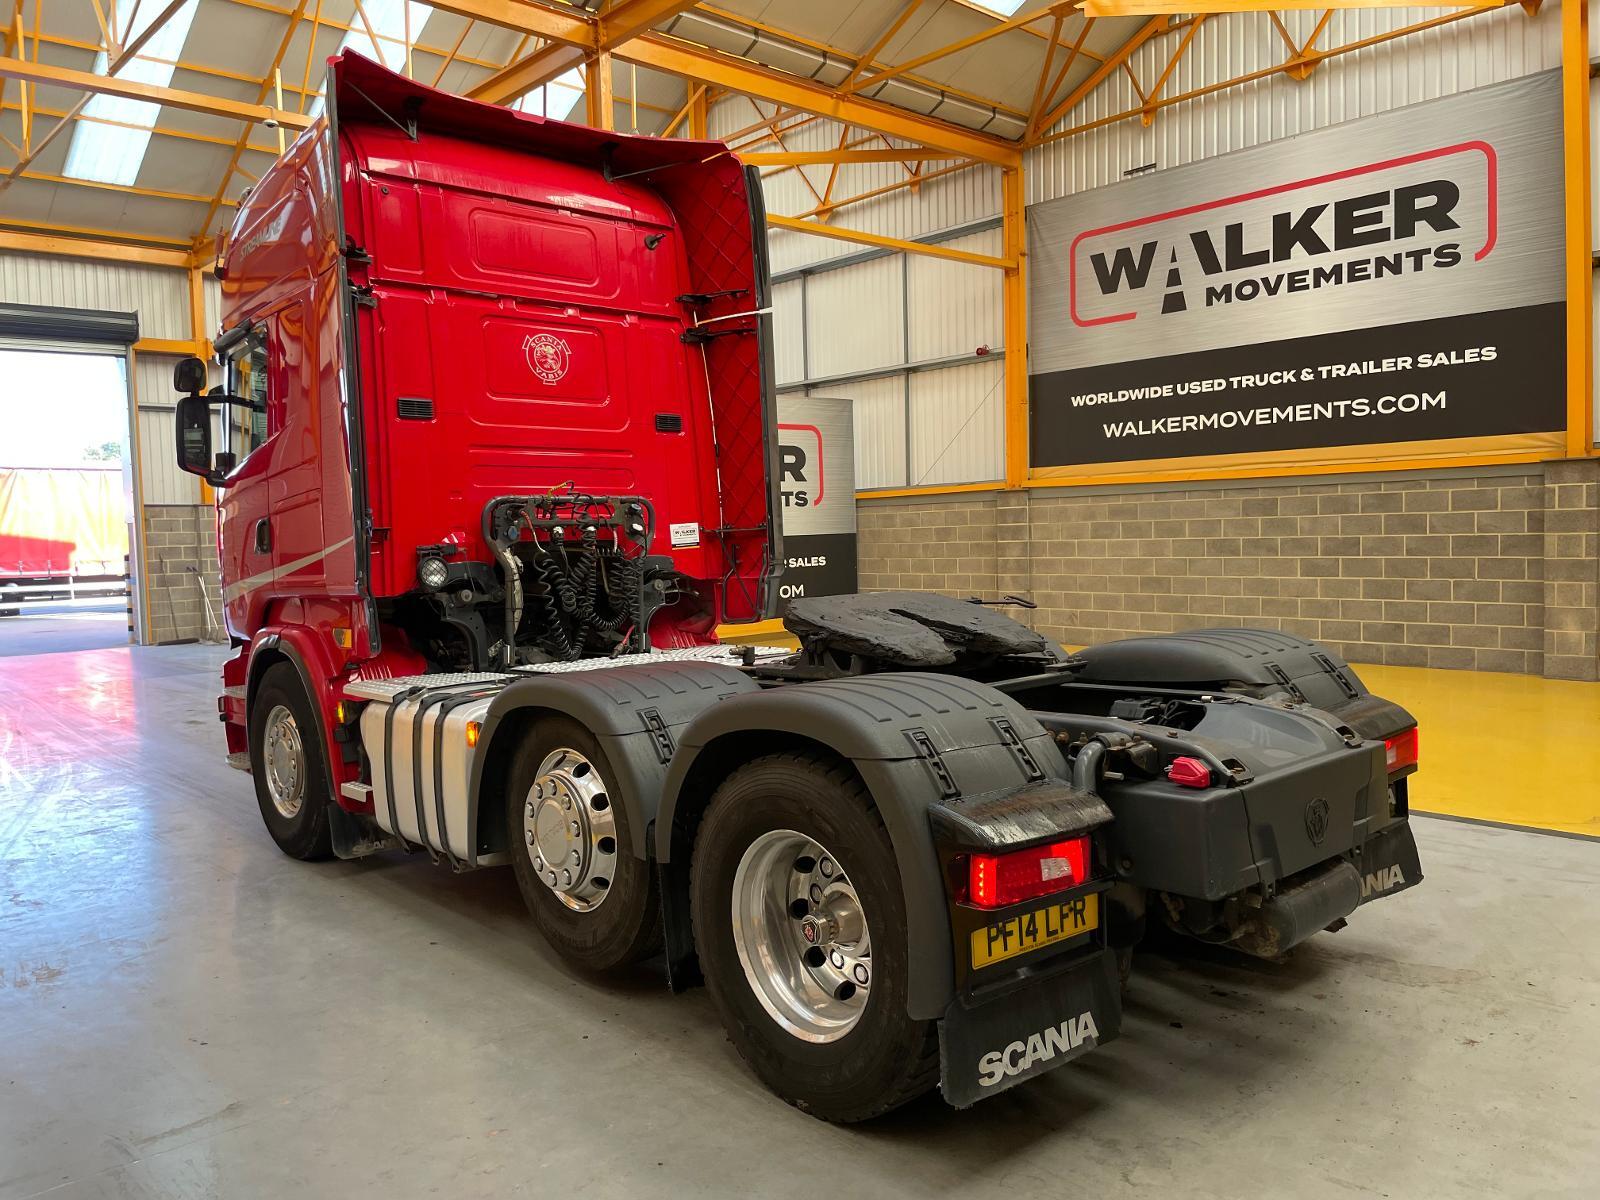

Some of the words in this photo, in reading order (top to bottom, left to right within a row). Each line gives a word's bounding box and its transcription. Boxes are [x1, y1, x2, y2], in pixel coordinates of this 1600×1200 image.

[1090, 179, 1462, 315] WALKER
[1205, 243, 1462, 307] MOVEMENTS
[530, 336, 563, 352] SCANIA
[1070, 384, 1174, 407] WORLDWIDE
[1176, 378, 1227, 395] USED
[1229, 370, 1297, 389] TRUCK
[1300, 368, 1315, 382] &
[1318, 356, 1413, 380] TRAILER
[1416, 346, 1498, 369] SALES
[1102, 390, 1447, 439] WALKERMOVEMENTS.COM
[788, 556, 827, 568] SALES
[986, 911, 1039, 957] PF14
[1045, 897, 1087, 938] LFR
[977, 1010, 1100, 1087] SCANIA
